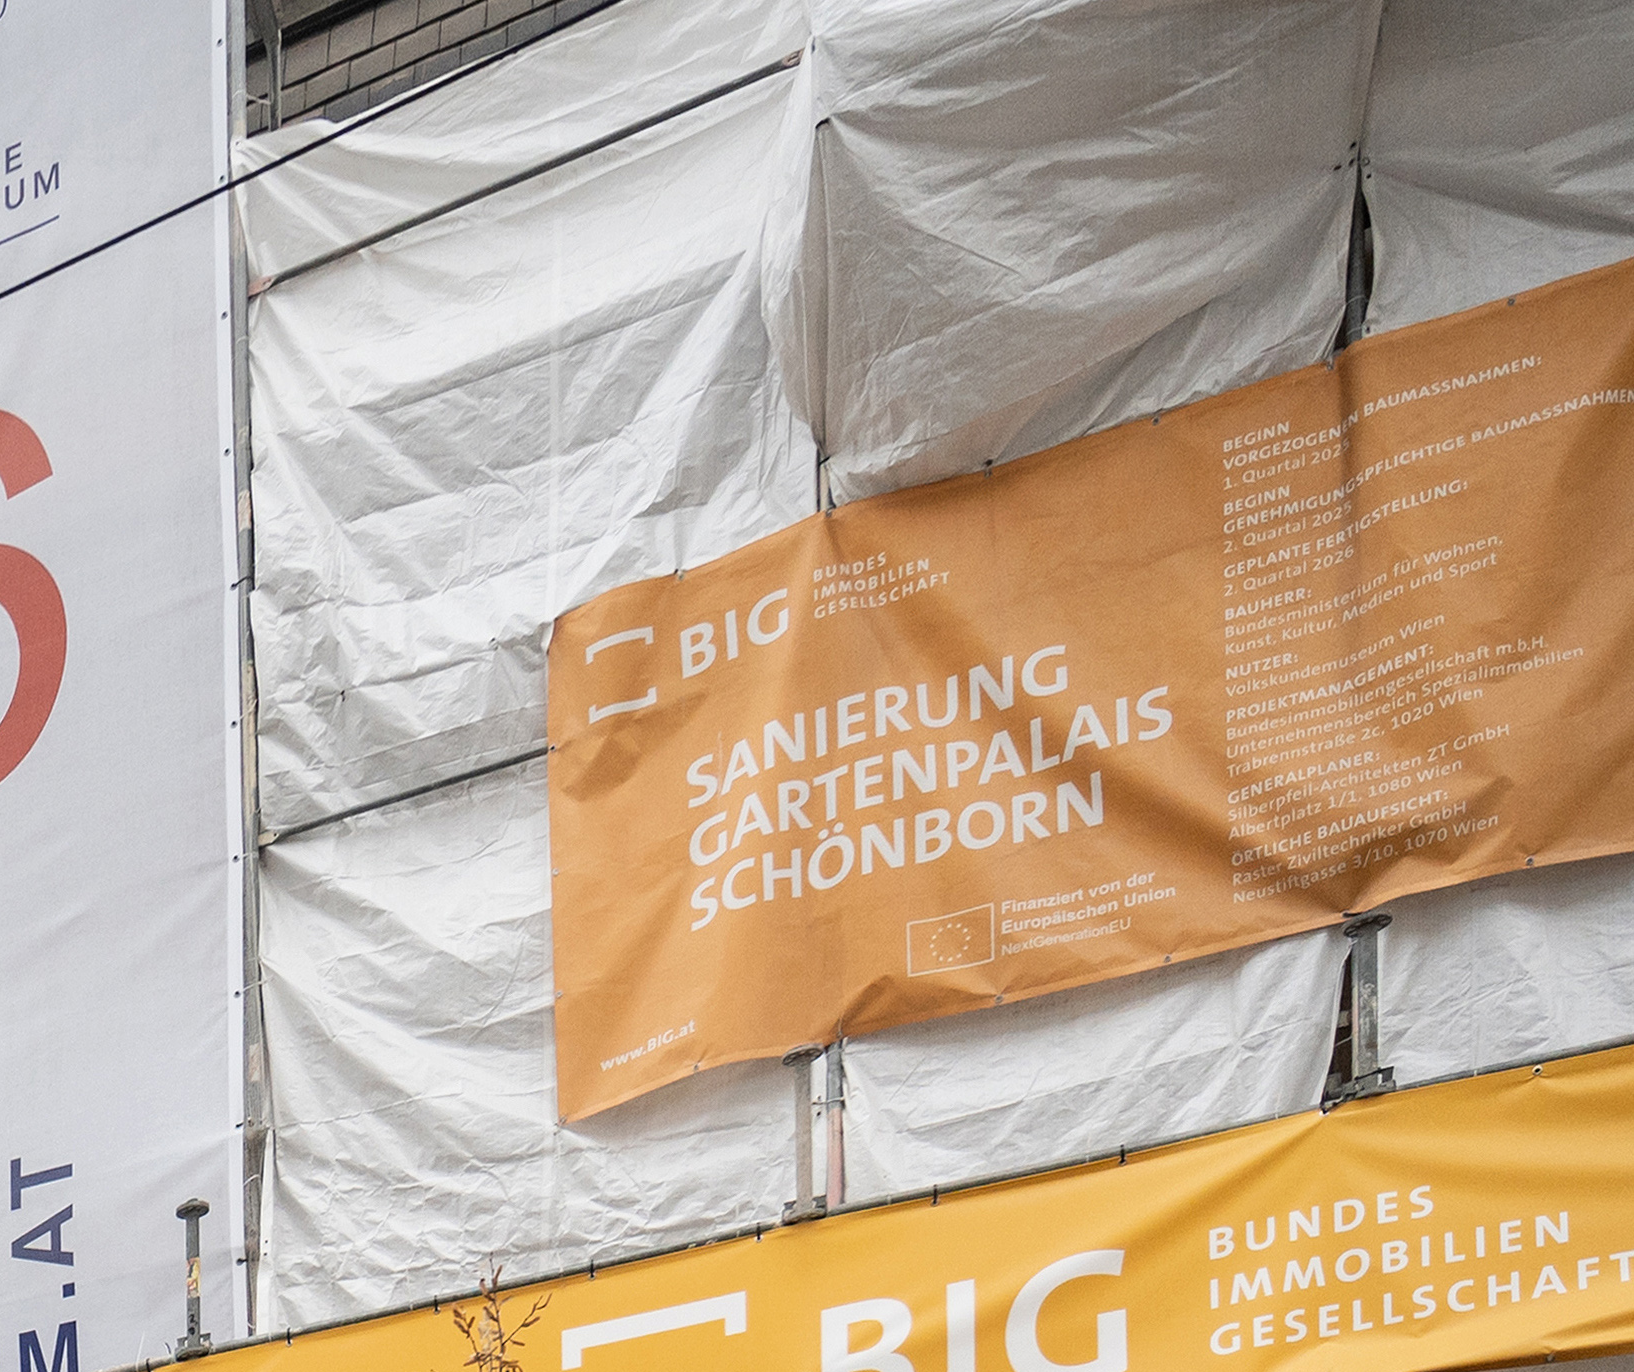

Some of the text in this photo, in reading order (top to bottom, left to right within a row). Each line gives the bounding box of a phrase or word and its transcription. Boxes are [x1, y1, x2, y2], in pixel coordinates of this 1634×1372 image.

[1222, 356, 1542, 470] VORGEZOGENEN BAUMASSNAHMEN:
[1223, 421, 1290, 452] BEGINN
[1223, 439, 1350, 490] 1. Quartal 2025
[1223, 435, 1466, 534] GENEHMIGUNGSPFLICHTIGE
[1223, 485, 1290, 516] BEGINN
[813, 552, 886, 582] BUNDES
[1224, 501, 1352, 554] 2. Quartal 2025
[1224, 479, 1468, 579] GEPLANTE FERTIGSTELLUNG:
[814, 558, 929, 602] IMMOBILIEN
[814, 571, 949, 619] GESELLSCHAFT
[1224, 545, 1354, 597] 2. Quartal 2026
[1224, 536, 1503, 639] Bundesministerium für Wohnen,
[1224, 587, 1312, 621] BAUHERR:
[1225, 553, 1497, 655] Kunst, Kultur, Medien und Sport
[679, 589, 789, 680] BIG
[1225, 653, 1299, 680] NUTZER:
[1226, 614, 1444, 697] Volkskundemuseum Wien
[1226, 643, 1433, 723] PROJEKTMANAGEMENT:
[1226, 645, 1490, 741] Bundesimmobiliengesellschaft
[1226, 647, 1584, 759] Unternehmensbereich Spezialimmobilien
[685, 644, 1068, 809] SANIERUNG
[1226, 734, 1355, 778] Trabrennstraße
[1391, 702, 1434, 730] 1020
[1439, 688, 1483, 709] Wien
[688, 686, 1174, 869] GARTENPALAIS
[1227, 751, 1380, 804] GENERALPLANER:
[1228, 724, 1509, 822] Silberpfeil-Architekten ZT GmbH
[1229, 802, 1322, 840] Albertplatz
[1369, 775, 1412, 798] 1080
[1417, 760, 1462, 782] Wien
[690, 771, 1104, 932] SCHÖNBORN
[1231, 789, 1449, 866] ÖRTLICHE BAUAUFSICHT:
[1233, 801, 1466, 887] Raster Ziviltechniker GmbH
[1234, 861, 1346, 904] Neustiftgasse
[1405, 828, 1447, 852] 1070
[1453, 815, 1498, 836] Wien
[1001, 871, 1155, 914] Finanziert von der
[1001, 887, 1176, 934] Europäischen Union
[1001, 917, 1131, 956] NextGenerationEU
[599, 1020, 696, 1073] www.BIG.at
[1208, 1184, 1434, 1261] BUNDES
[1209, 1211, 1570, 1309] IMMOBILIEN
[1209, 1250, 1634, 1356] GESELLSCHAFT
